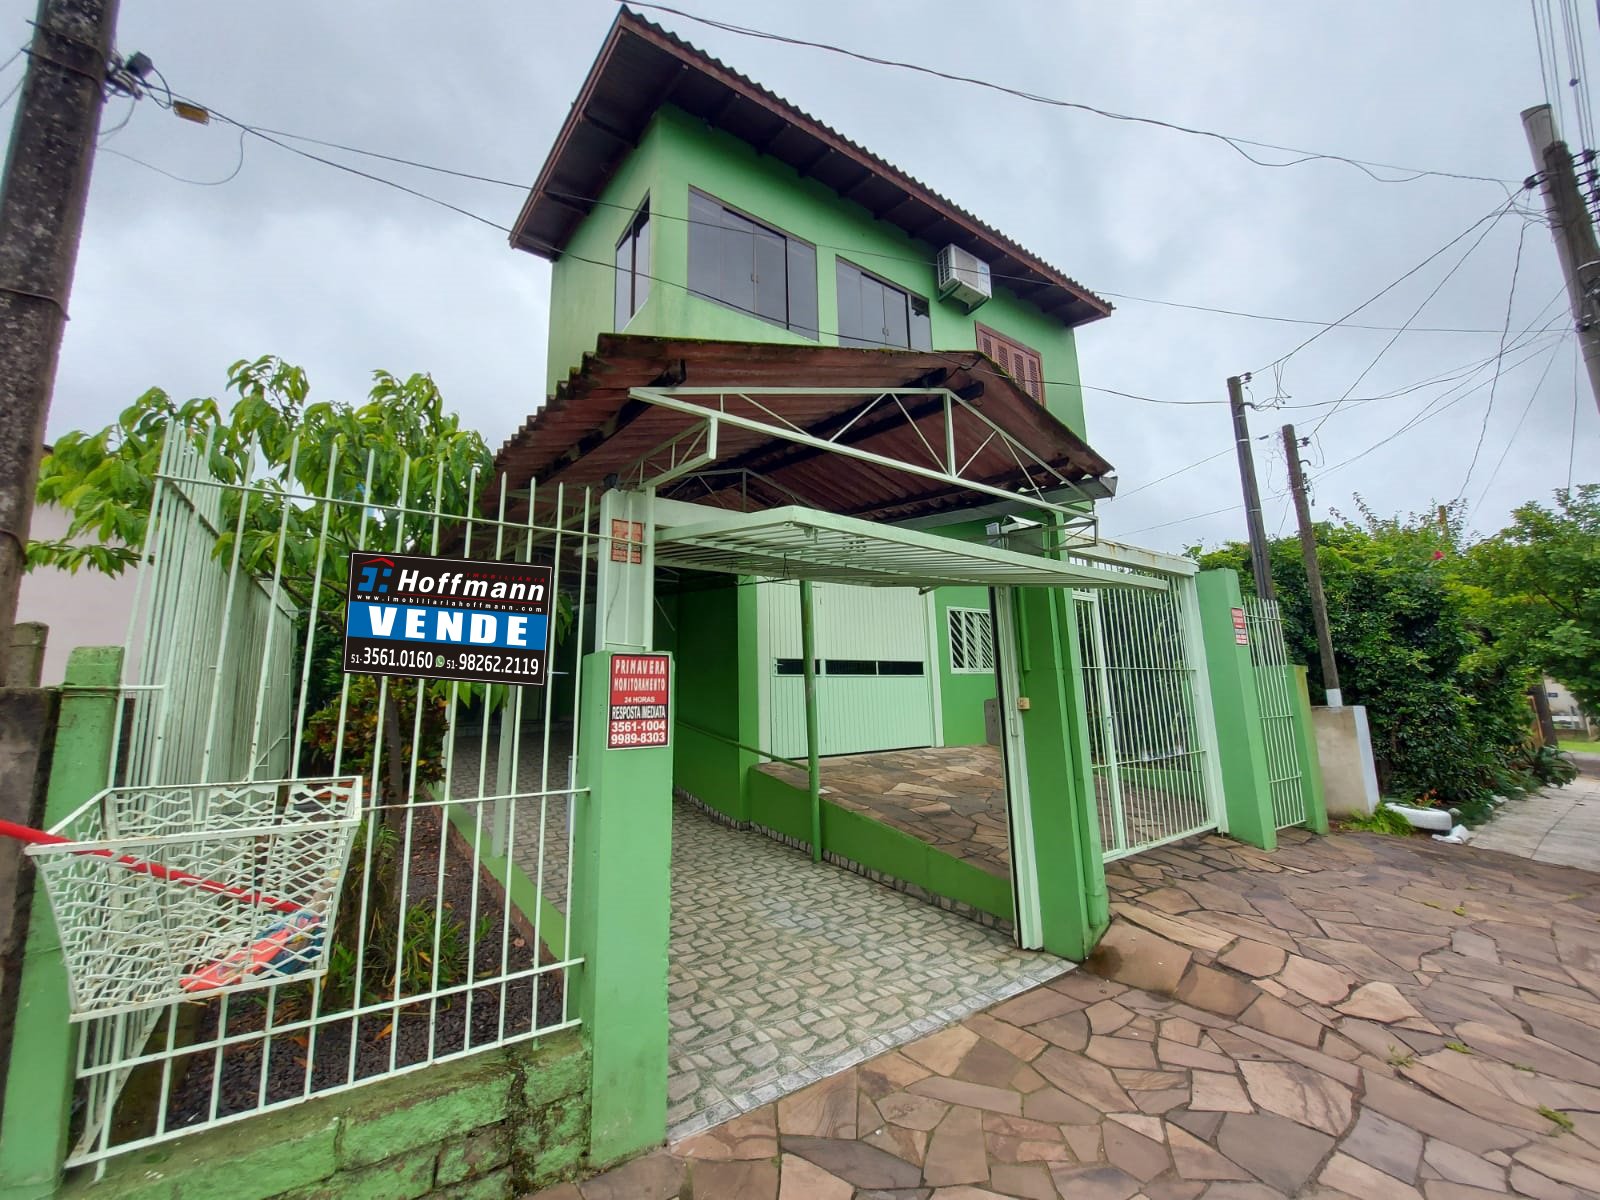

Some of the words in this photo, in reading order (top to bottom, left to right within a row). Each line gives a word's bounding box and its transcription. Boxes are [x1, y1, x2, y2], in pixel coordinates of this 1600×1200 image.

[397, 569, 544, 601] Hoffmann
[356, 594, 542, 613] www.imobiliariahoffmann.com
[368, 605, 528, 647] VENDE
[615, 659, 665, 675] PRIMAVERA
[614, 677, 666, 692] MONITORAMENTO
[612, 705, 641, 720] RESPOSTA
[611, 720, 666, 733] 3561-1004
[611, 732, 666, 745] 9989-8303
